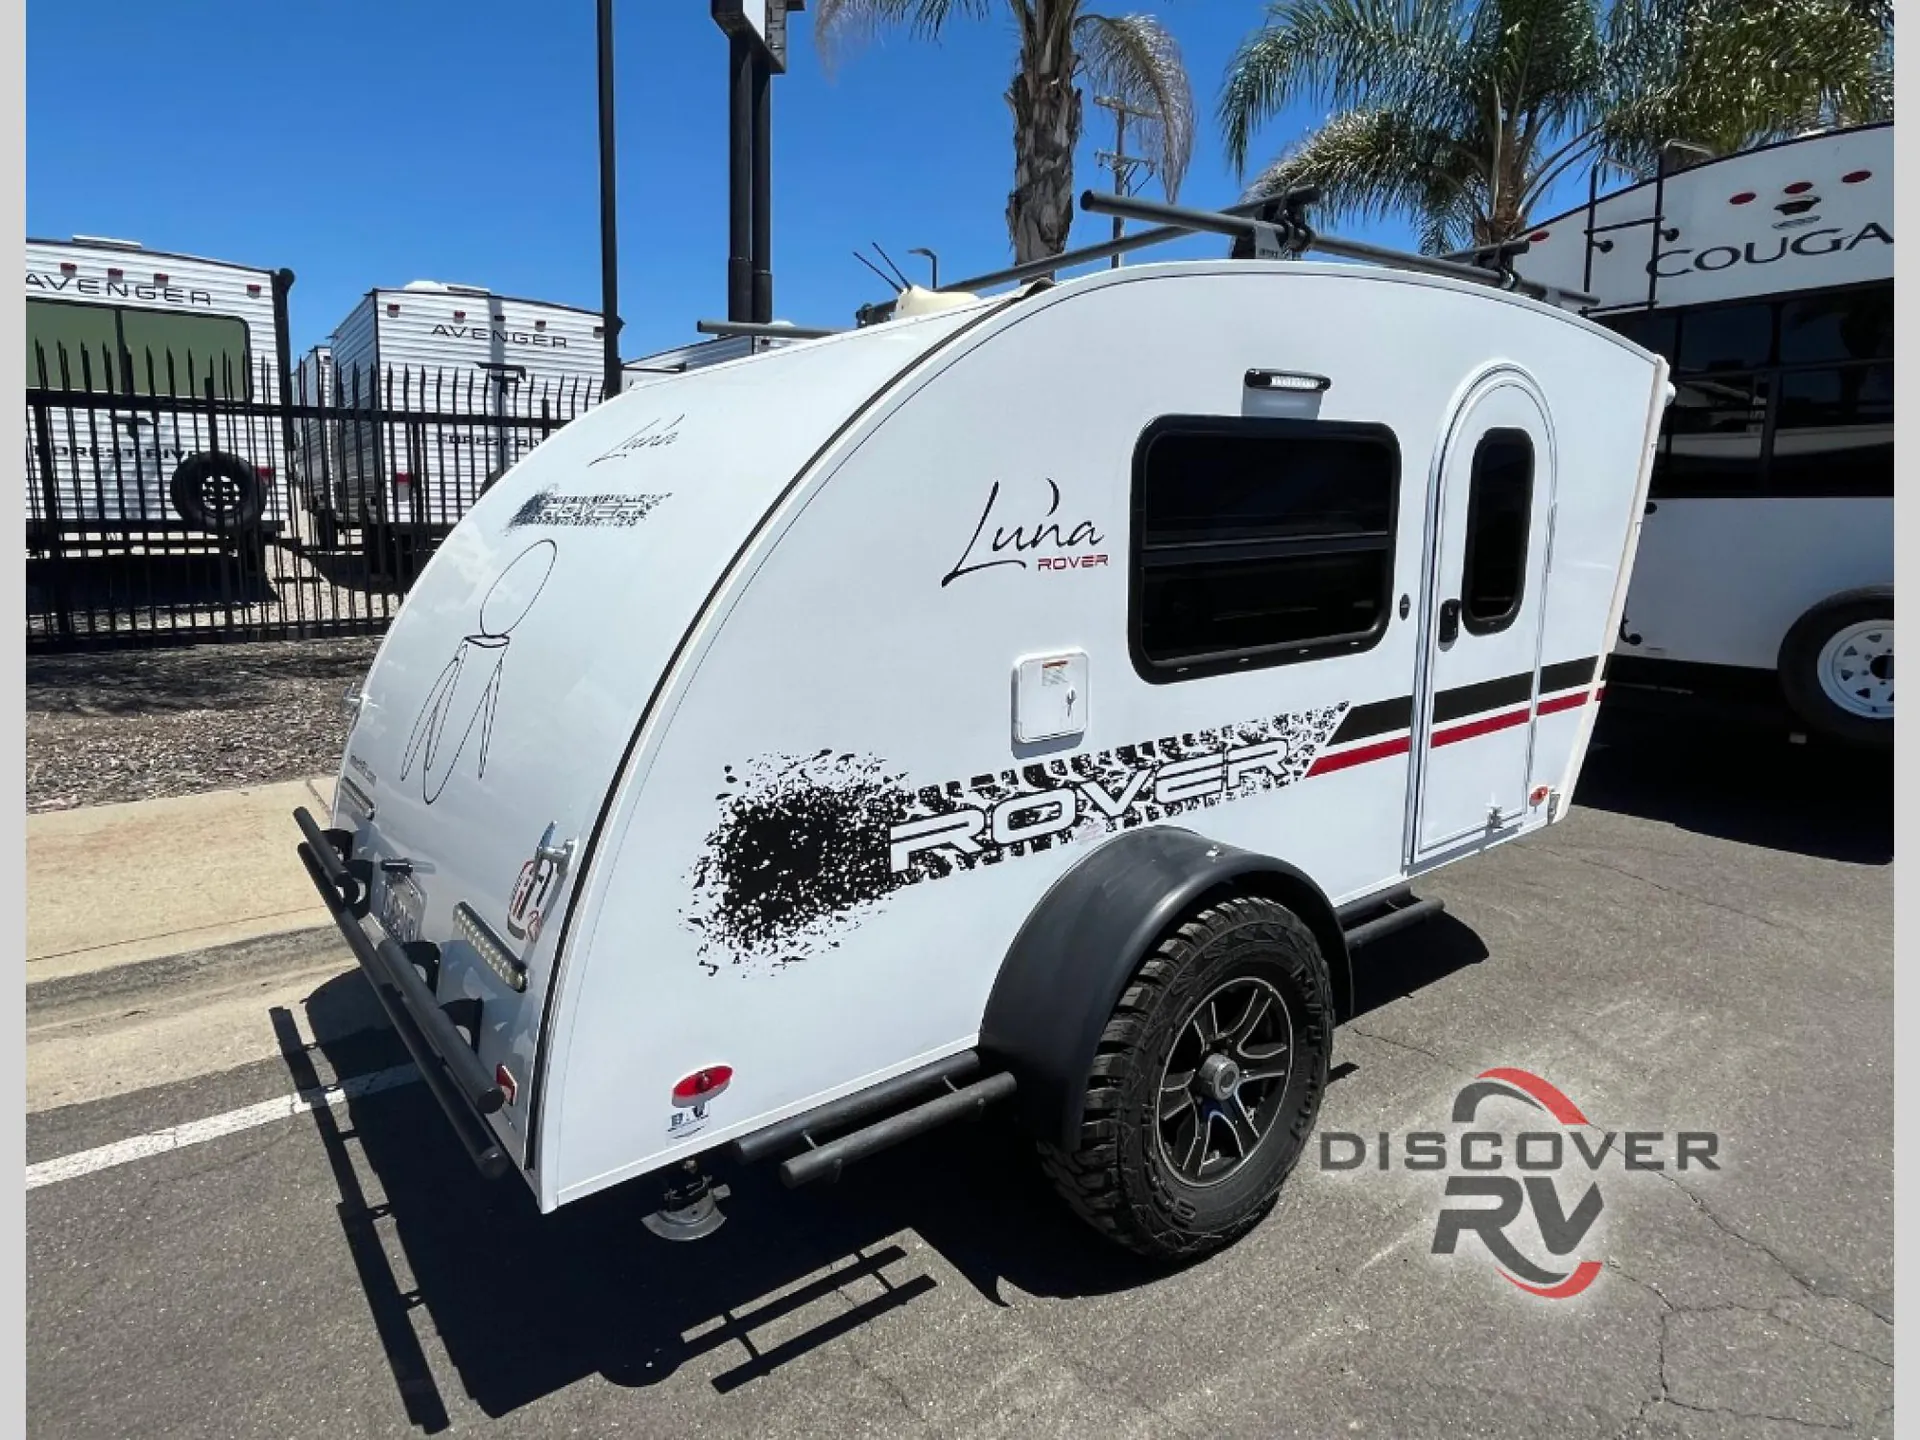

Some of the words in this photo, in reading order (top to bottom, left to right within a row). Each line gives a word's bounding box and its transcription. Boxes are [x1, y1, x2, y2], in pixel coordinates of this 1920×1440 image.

[25, 273, 211, 306] AVENGER
[430, 324, 567, 348] AVENGER
[941, 477, 1105, 588] Luna
[1037, 554, 1109, 571] ROVER
[889, 738, 1290, 874] ROVER
